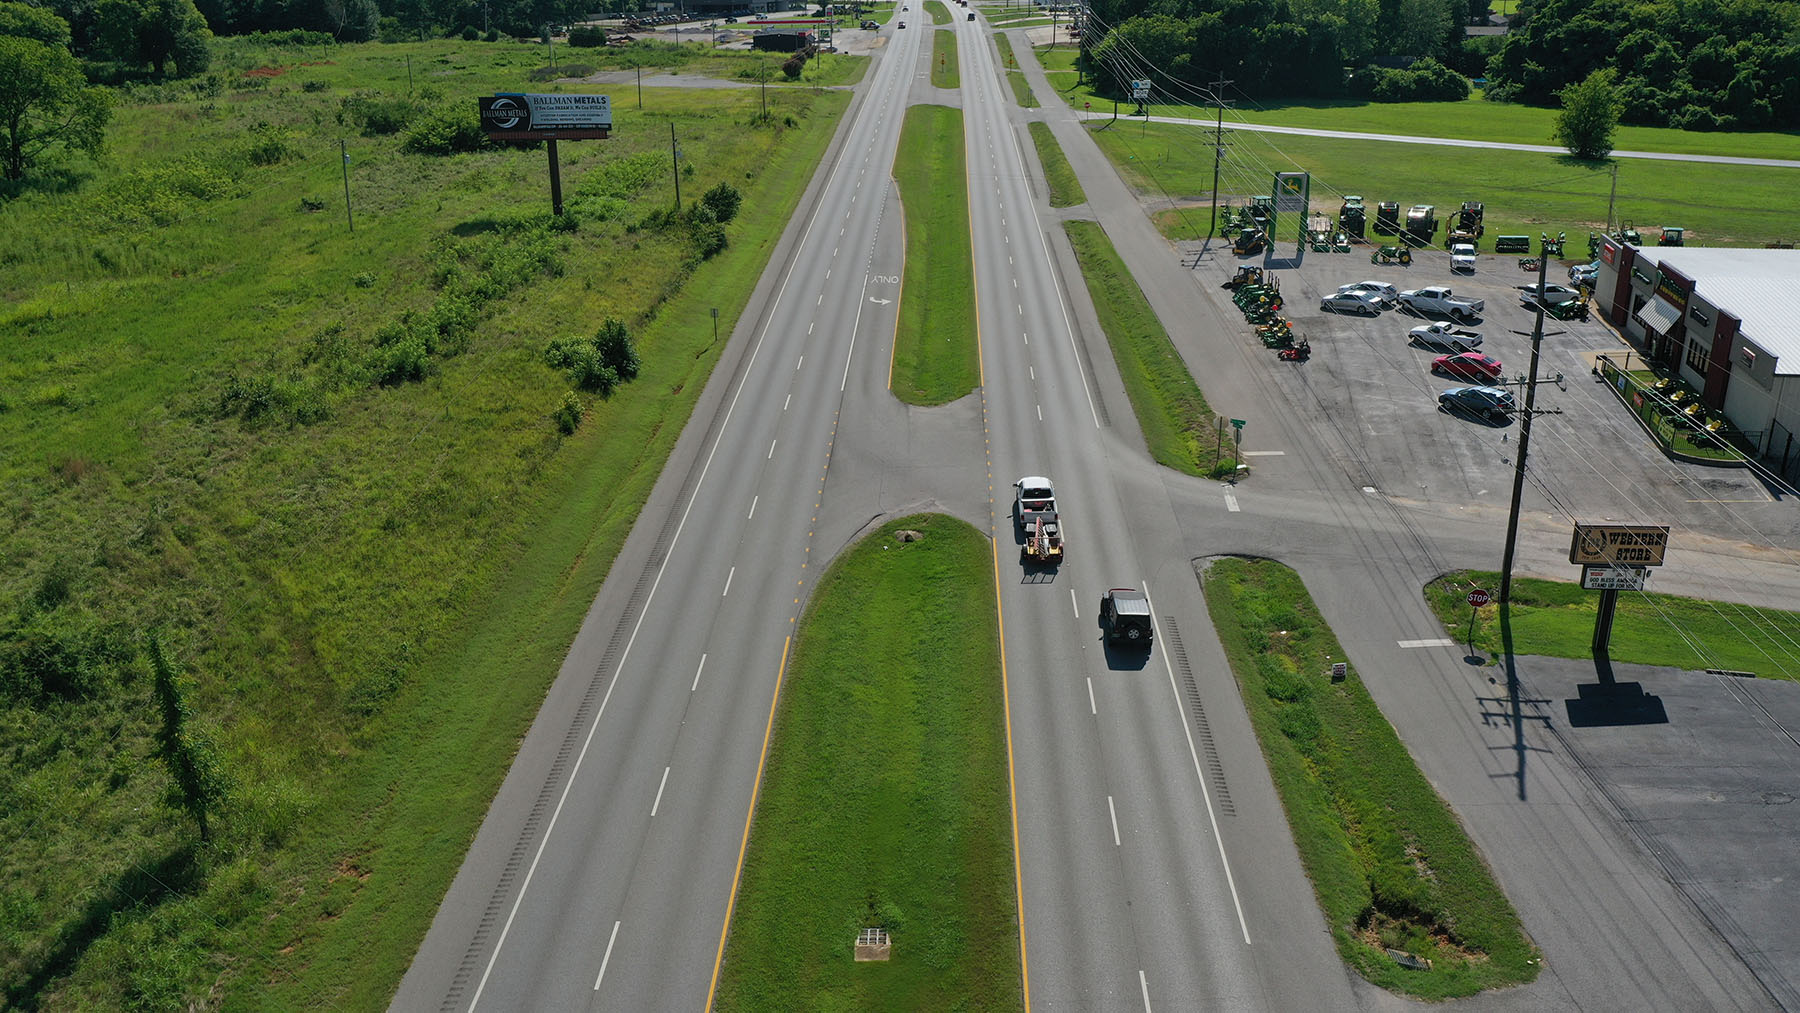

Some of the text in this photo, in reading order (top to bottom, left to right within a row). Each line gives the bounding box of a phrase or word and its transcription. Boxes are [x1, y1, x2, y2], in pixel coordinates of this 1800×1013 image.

[534, 97, 572, 105] BALLMAN
[482, 109, 528, 118] BALLMAN METALS
[871, 275, 899, 284] ONLY
[1609, 532, 1664, 546] WESTERN
[1616, 548, 1652, 561] STORE
[1468, 593, 1488, 602] STOP
